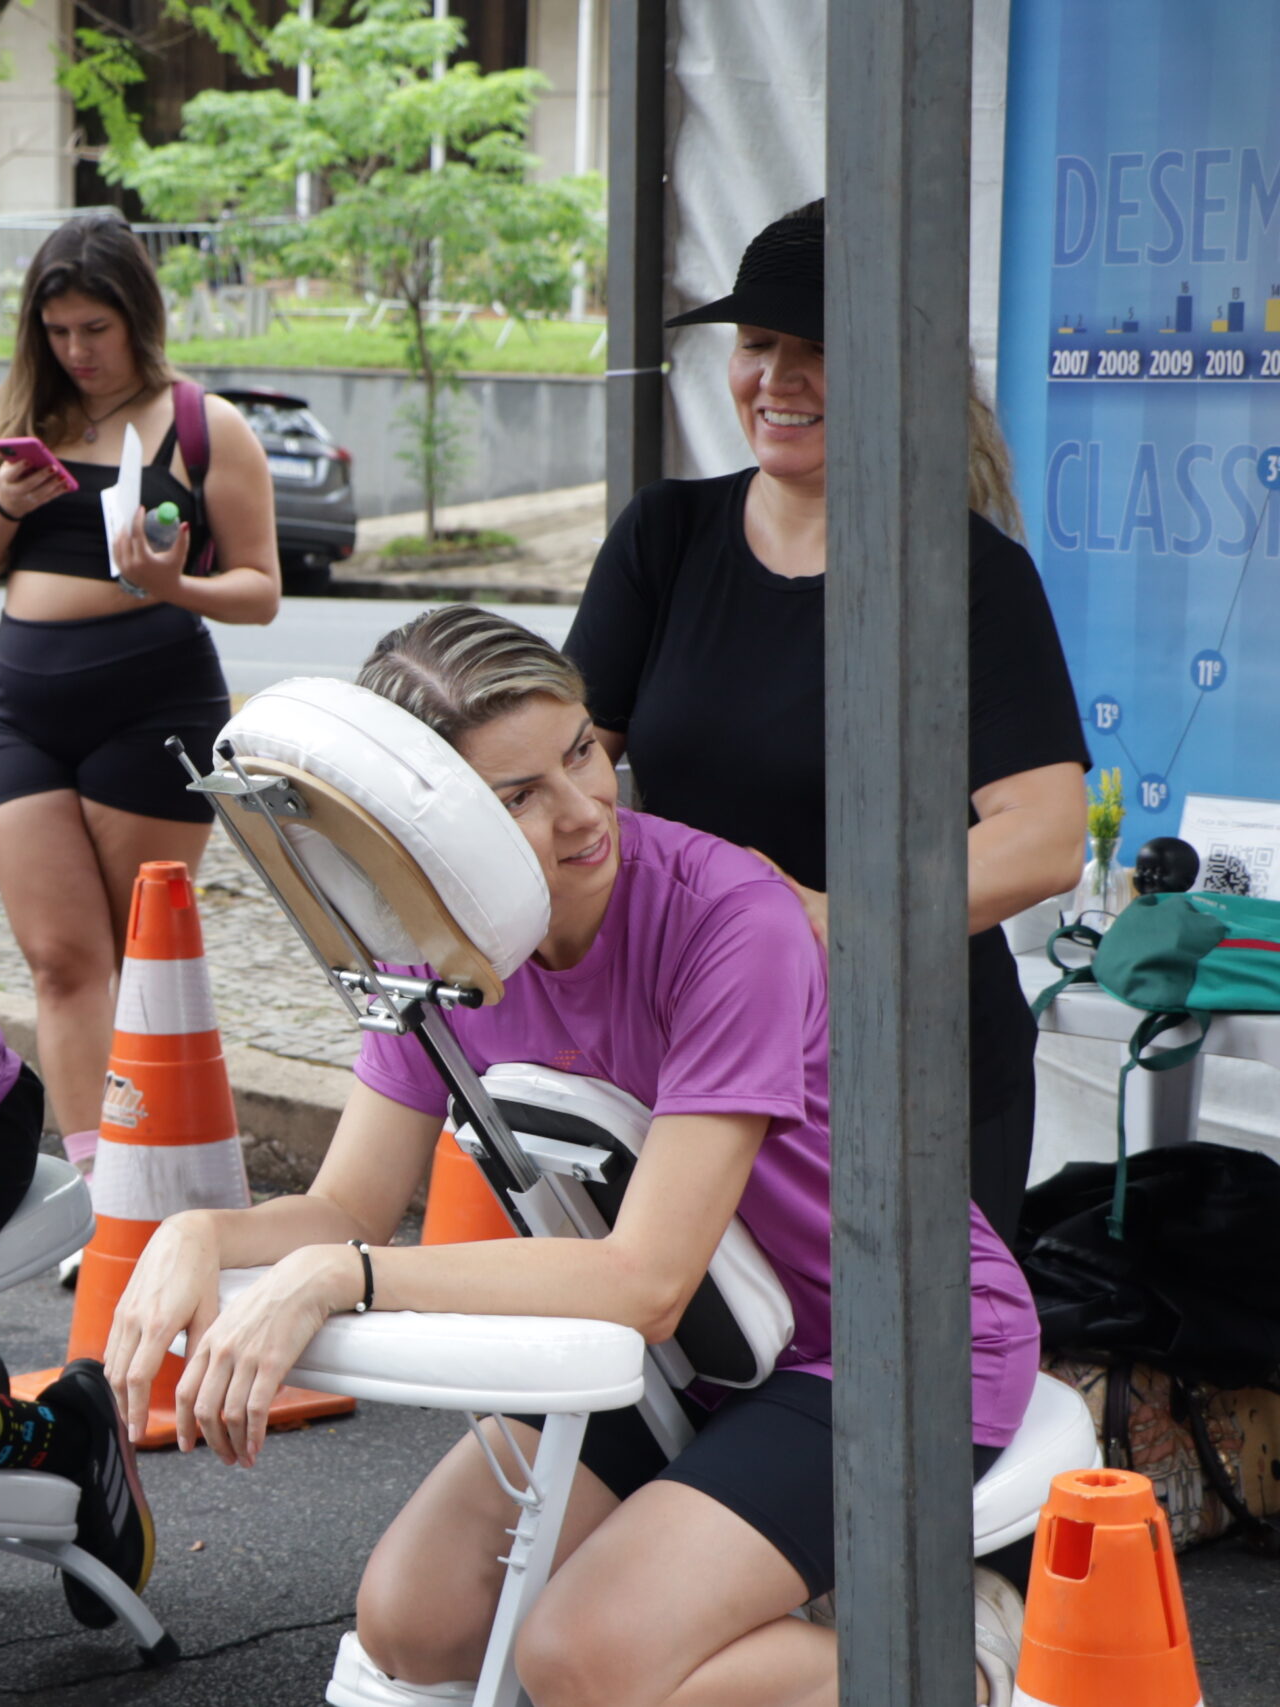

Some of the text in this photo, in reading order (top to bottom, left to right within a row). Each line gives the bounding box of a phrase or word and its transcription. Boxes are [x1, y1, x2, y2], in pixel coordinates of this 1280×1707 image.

[1051, 147, 1280, 268] DESEM
[1051, 349, 1280, 376] 2007 2008 2009 2010 20
[1198, 659, 1221, 687] 11º
[1095, 702, 1119, 729] 13º
[1141, 781, 1167, 808] 16º
